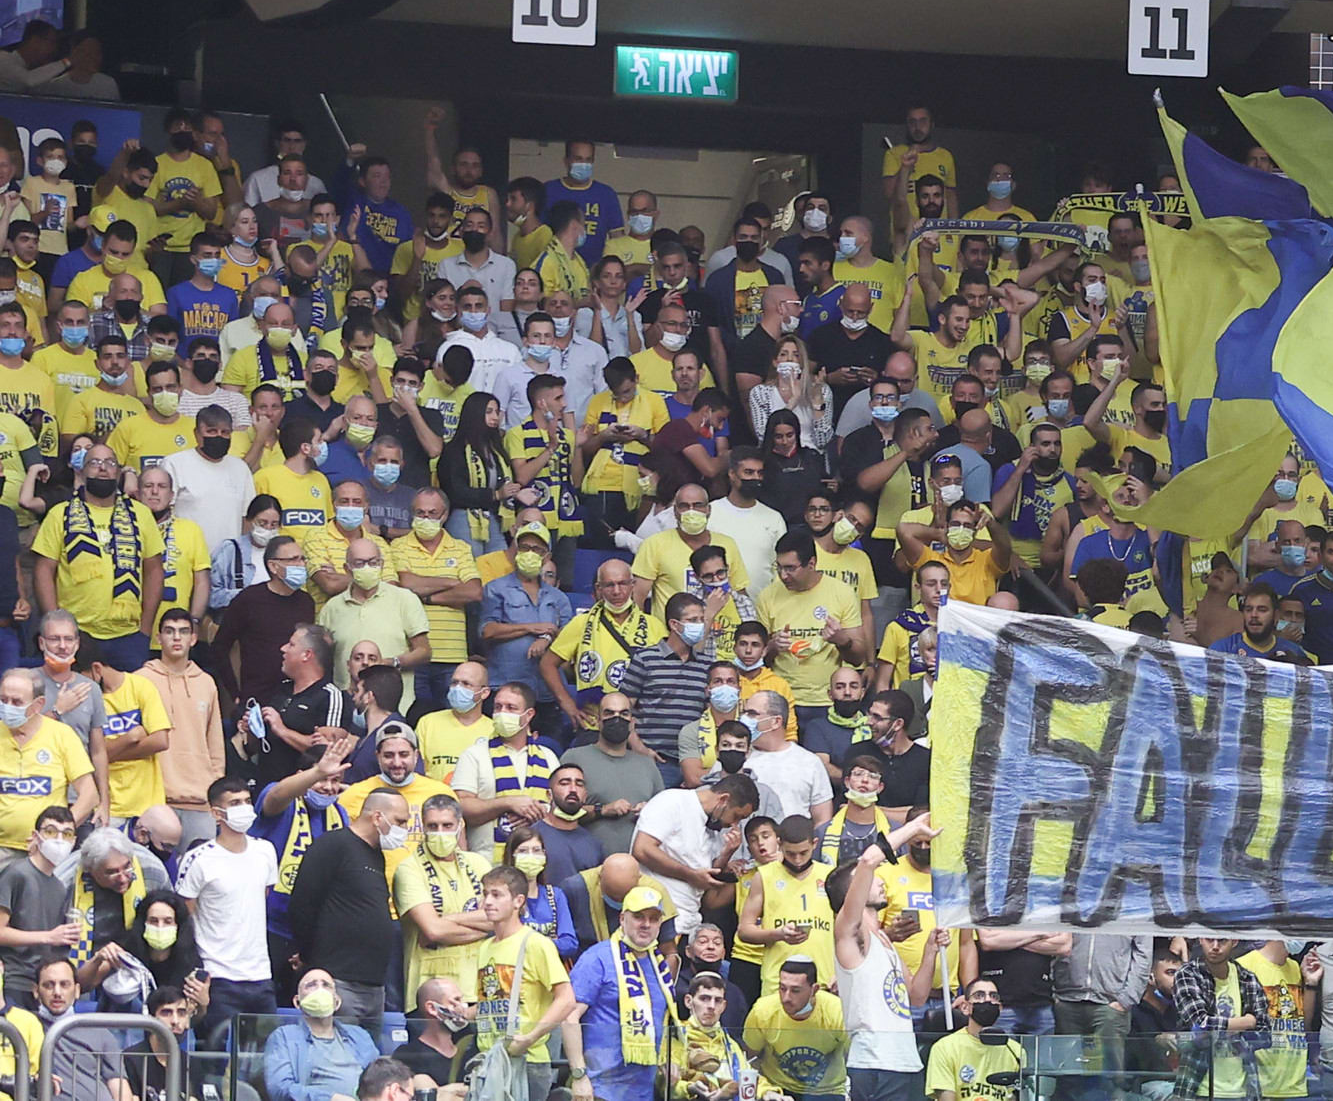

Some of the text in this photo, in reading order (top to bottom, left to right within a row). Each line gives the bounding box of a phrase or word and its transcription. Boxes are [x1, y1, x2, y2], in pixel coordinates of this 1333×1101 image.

[1140, 7, 1196, 58] 11
[657, 52, 729, 94] יציאה
[586, 203, 599, 217] 14
[286, 511, 323, 524] FOX
[2, 779, 49, 793] FOX
[801, 895, 807, 911] 1
